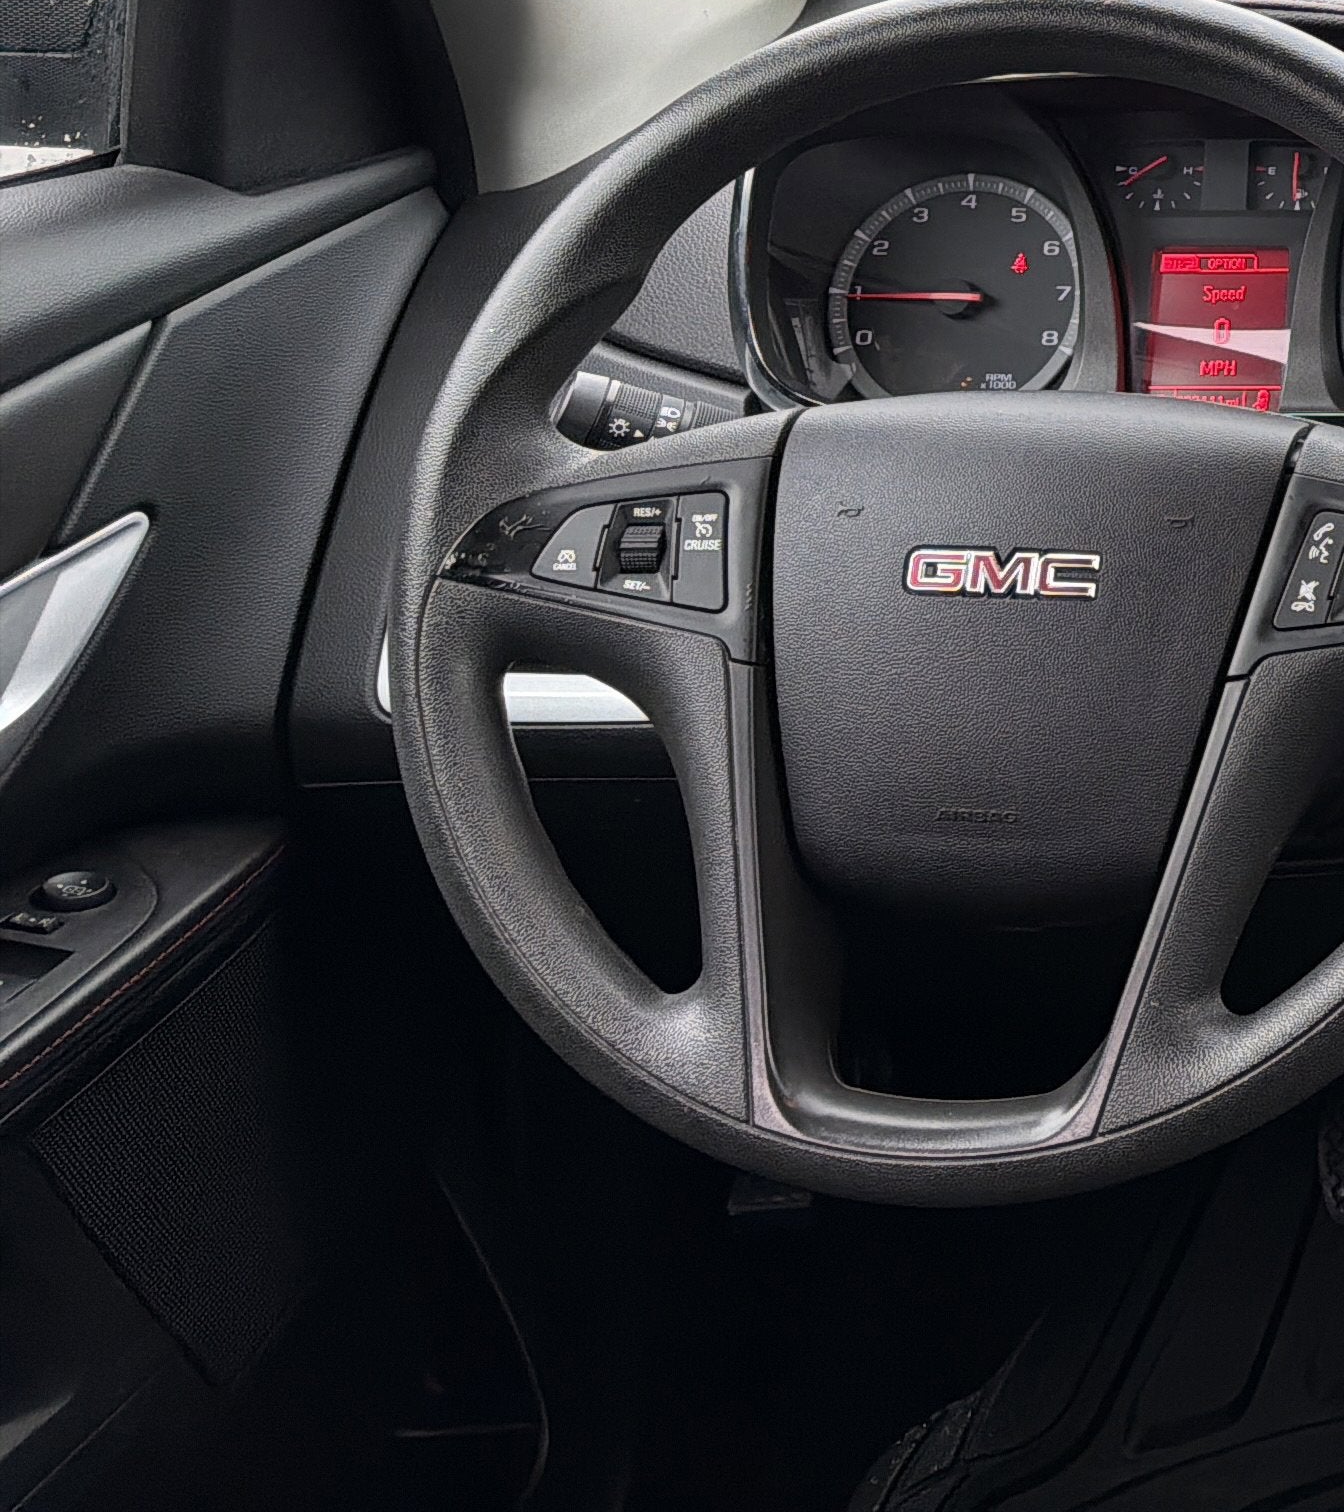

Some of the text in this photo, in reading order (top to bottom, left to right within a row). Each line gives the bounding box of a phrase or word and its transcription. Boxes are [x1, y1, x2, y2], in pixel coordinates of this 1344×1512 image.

[1183, 165, 1194, 175] H
[1267, 166, 1277, 176] E
[960, 194, 978, 210] 4
[912, 207, 929, 223] 3
[1010, 207, 1028, 223] 5
[871, 239, 890, 257] 2
[1043, 240, 1061, 257] 6
[1207, 258, 1247, 270] OPTION
[1055, 285, 1073, 302] 7
[1203, 285, 1247, 304] Speed
[855, 330, 873, 347] 0
[1041, 330, 1060, 347] 8
[1213, 317, 1231, 345] 0
[1199, 359, 1238, 377] MPH
[980, 380, 1017, 390] x1000
[985, 373, 1013, 382] RPM
[683, 539, 722, 551] CRUISE
[552, 563, 577, 572] CANCEL
[906, 549, 1101, 599] GMC
